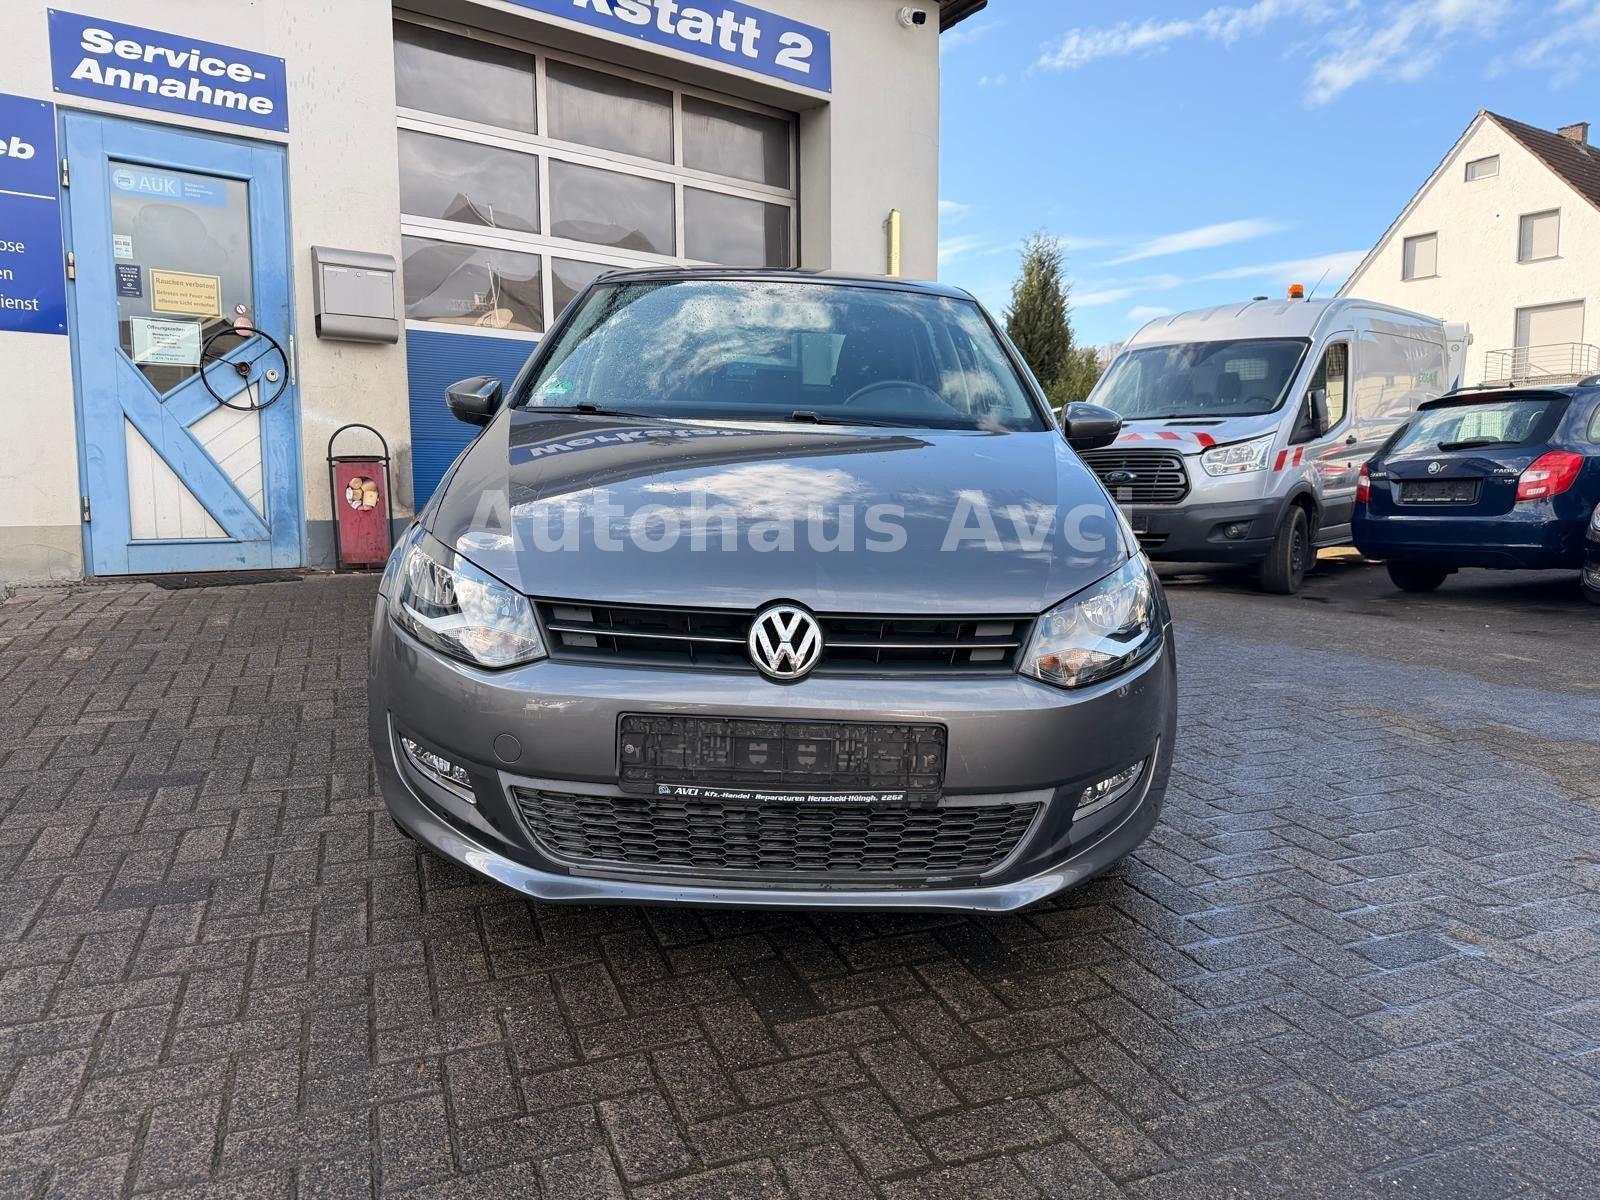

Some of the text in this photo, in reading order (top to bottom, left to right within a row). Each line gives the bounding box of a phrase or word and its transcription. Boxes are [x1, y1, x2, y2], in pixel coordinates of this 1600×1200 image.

[80, 27, 266, 83] Service-
[774, 31, 813, 73] 2
[70, 57, 274, 115] Annahme
[155, 277, 183, 287] Rauchen
[674, 786, 699, 796] AVCI
[704, 790, 750, 800] Kfz.-Handel
[755, 793, 805, 802] Reparaturen
